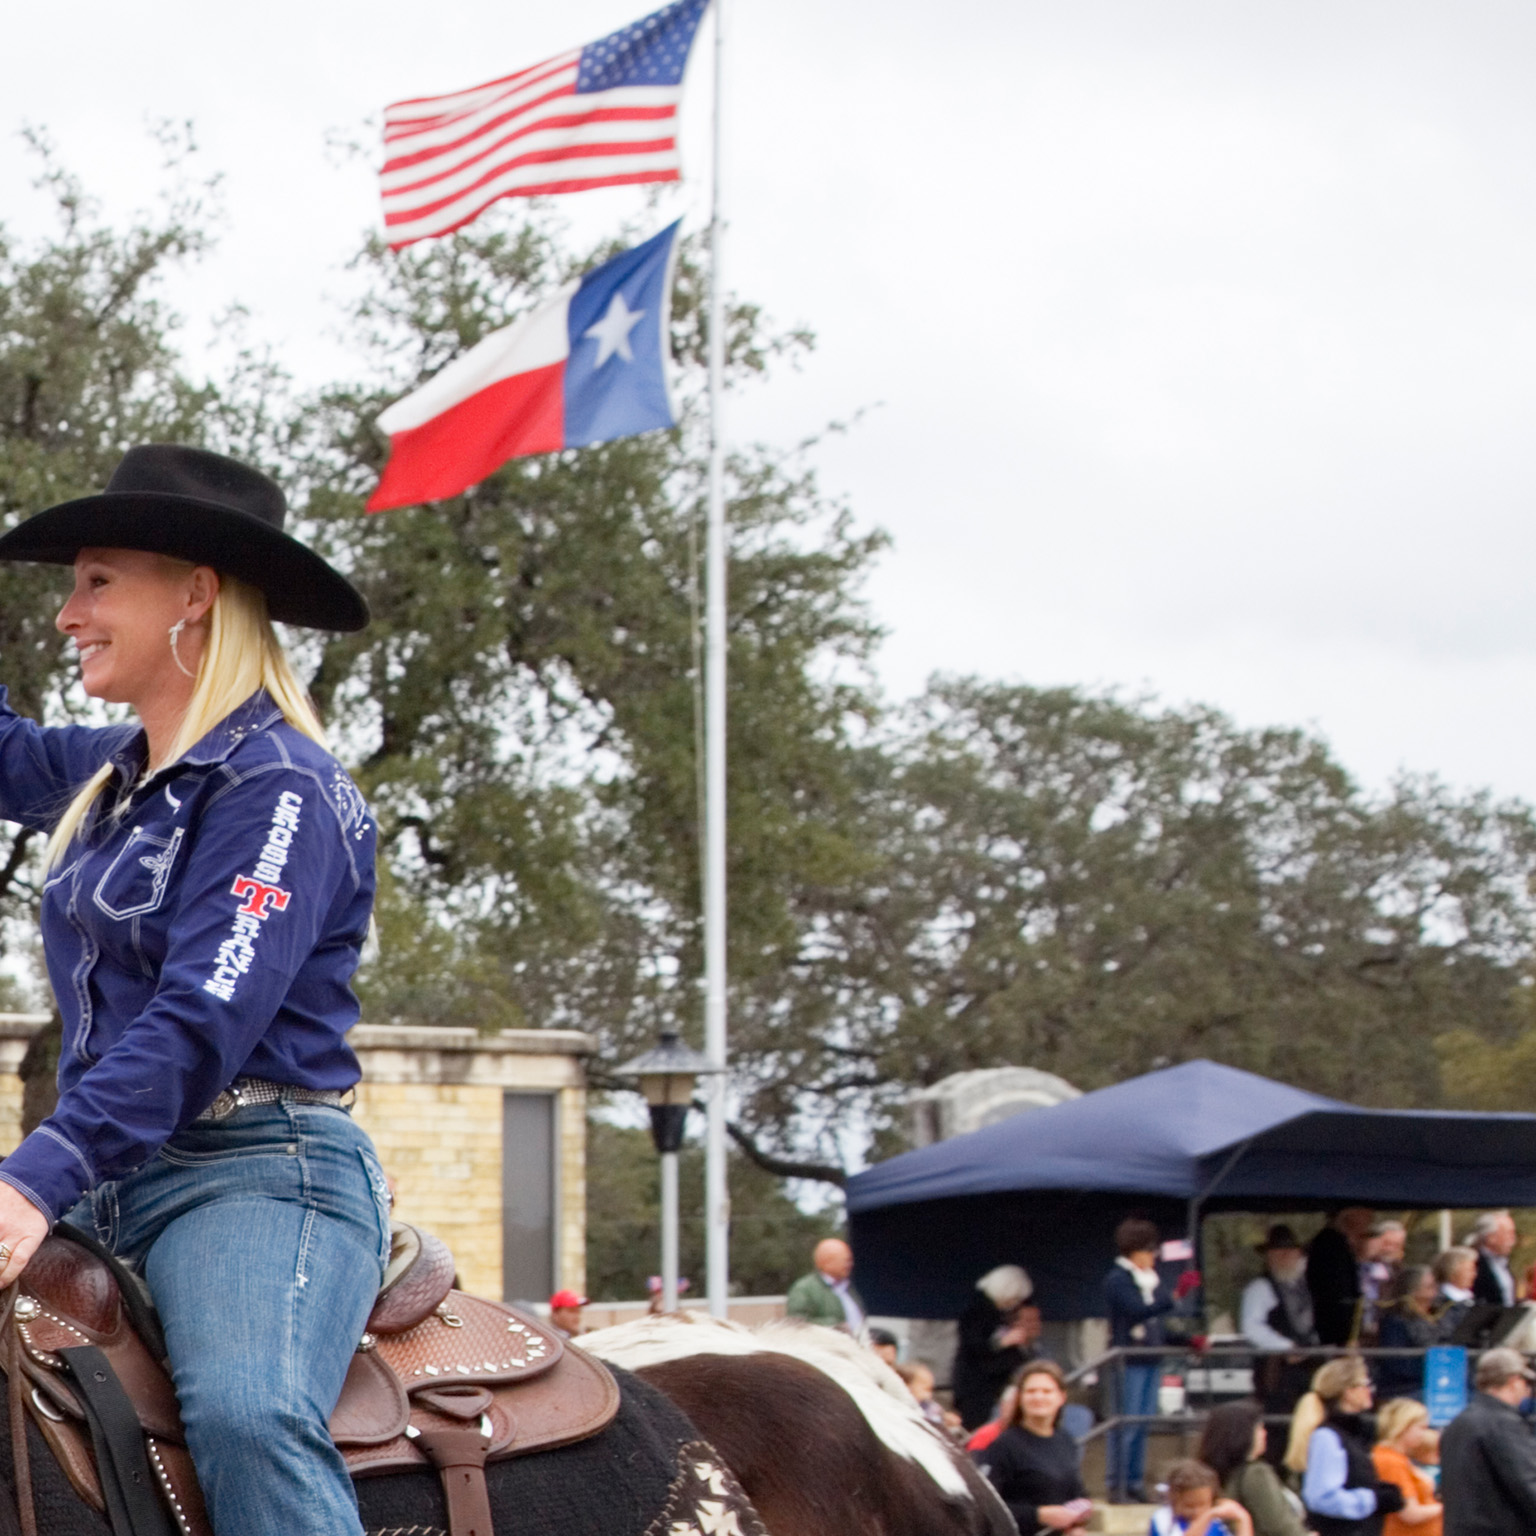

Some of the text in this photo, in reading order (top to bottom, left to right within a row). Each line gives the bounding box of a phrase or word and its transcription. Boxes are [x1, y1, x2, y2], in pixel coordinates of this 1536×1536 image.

[202, 790, 303, 1002] CROSS T RANCH
